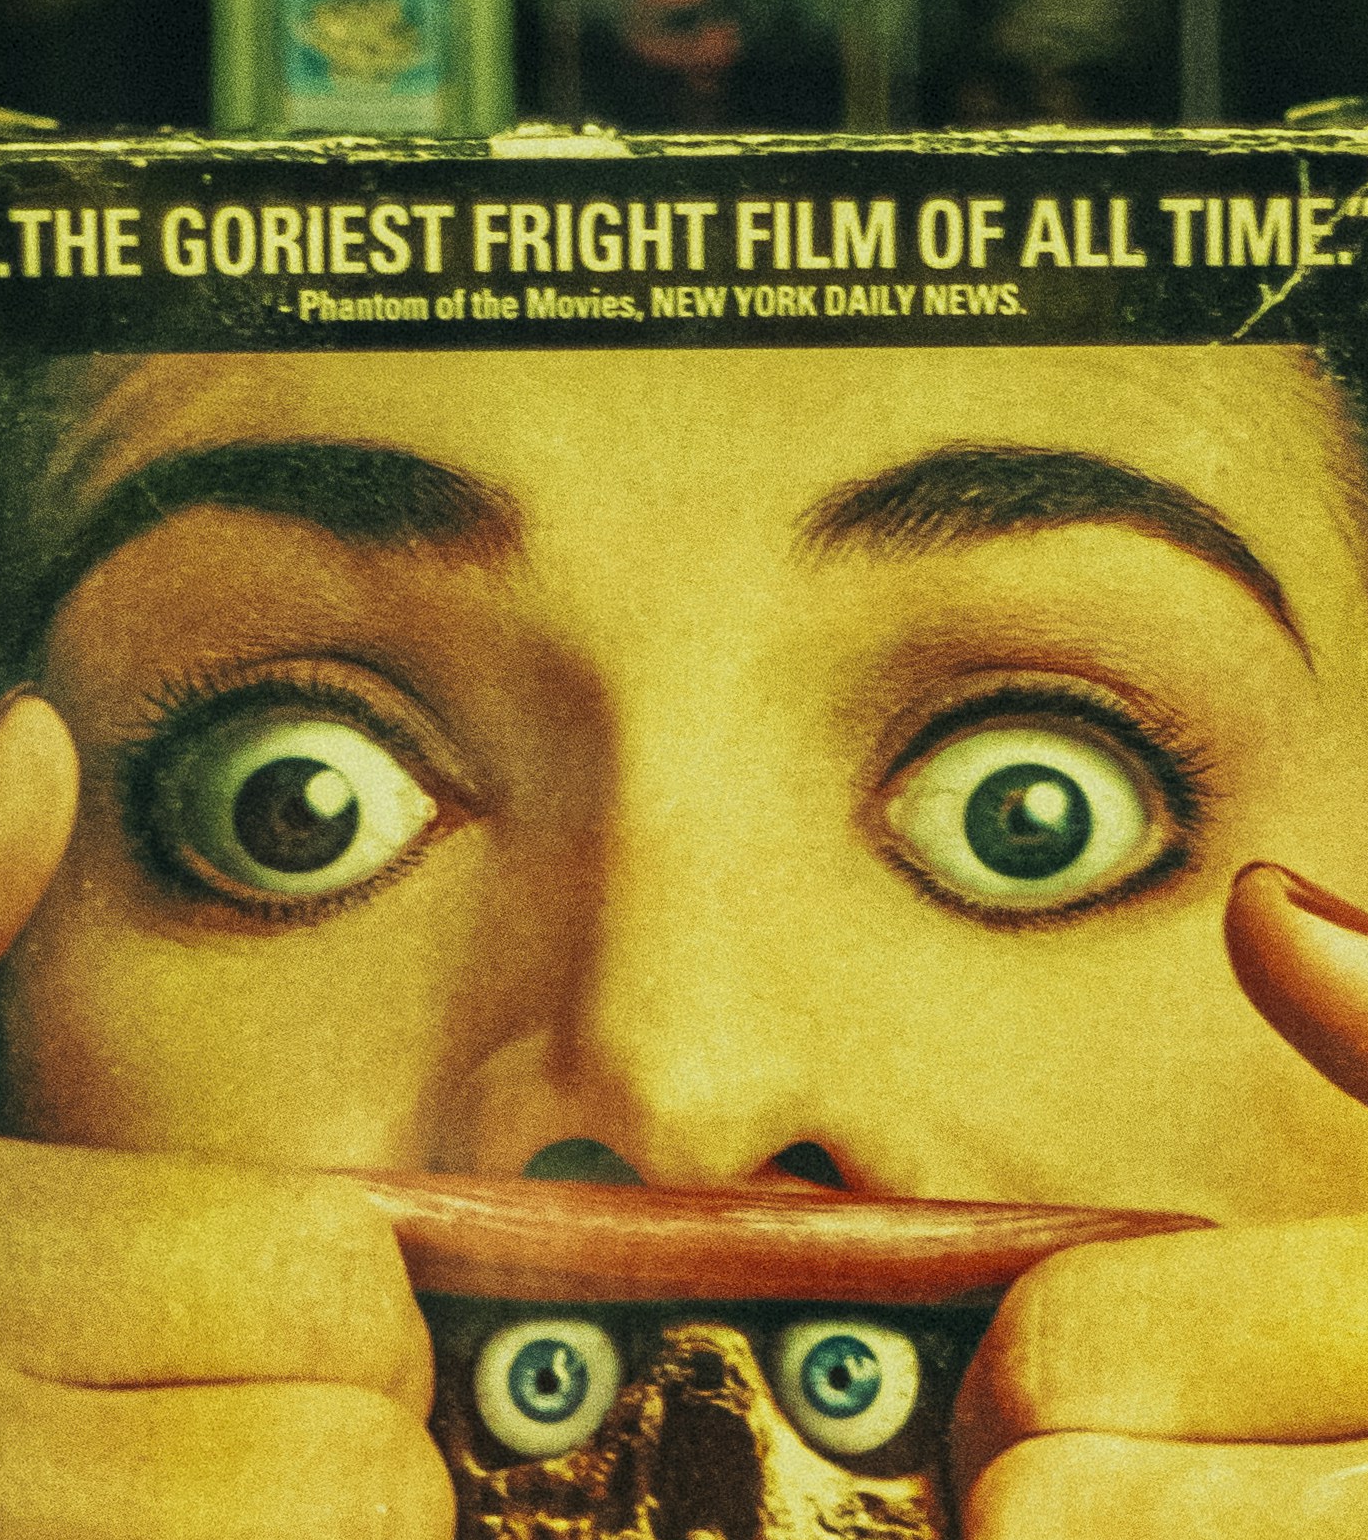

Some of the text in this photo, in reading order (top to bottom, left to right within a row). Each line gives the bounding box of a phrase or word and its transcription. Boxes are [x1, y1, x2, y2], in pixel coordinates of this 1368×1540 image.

[162, 205, 455, 277] GORIEST
[472, 200, 718, 274] FRIGHT
[736, 199, 898, 272] FILM
[918, 198, 1007, 271] OF
[1020, 197, 1148, 270] ALL
[299, 289, 429, 321] Phantom
[434, 289, 467, 321] of
[469, 289, 520, 320] the
[526, 289, 645, 324] Movies,
[650, 285, 727, 319] NEW
[732, 285, 818, 319] YORK
[824, 285, 916, 318] DAILY
[923, 283, 1029, 317] NEWS.
